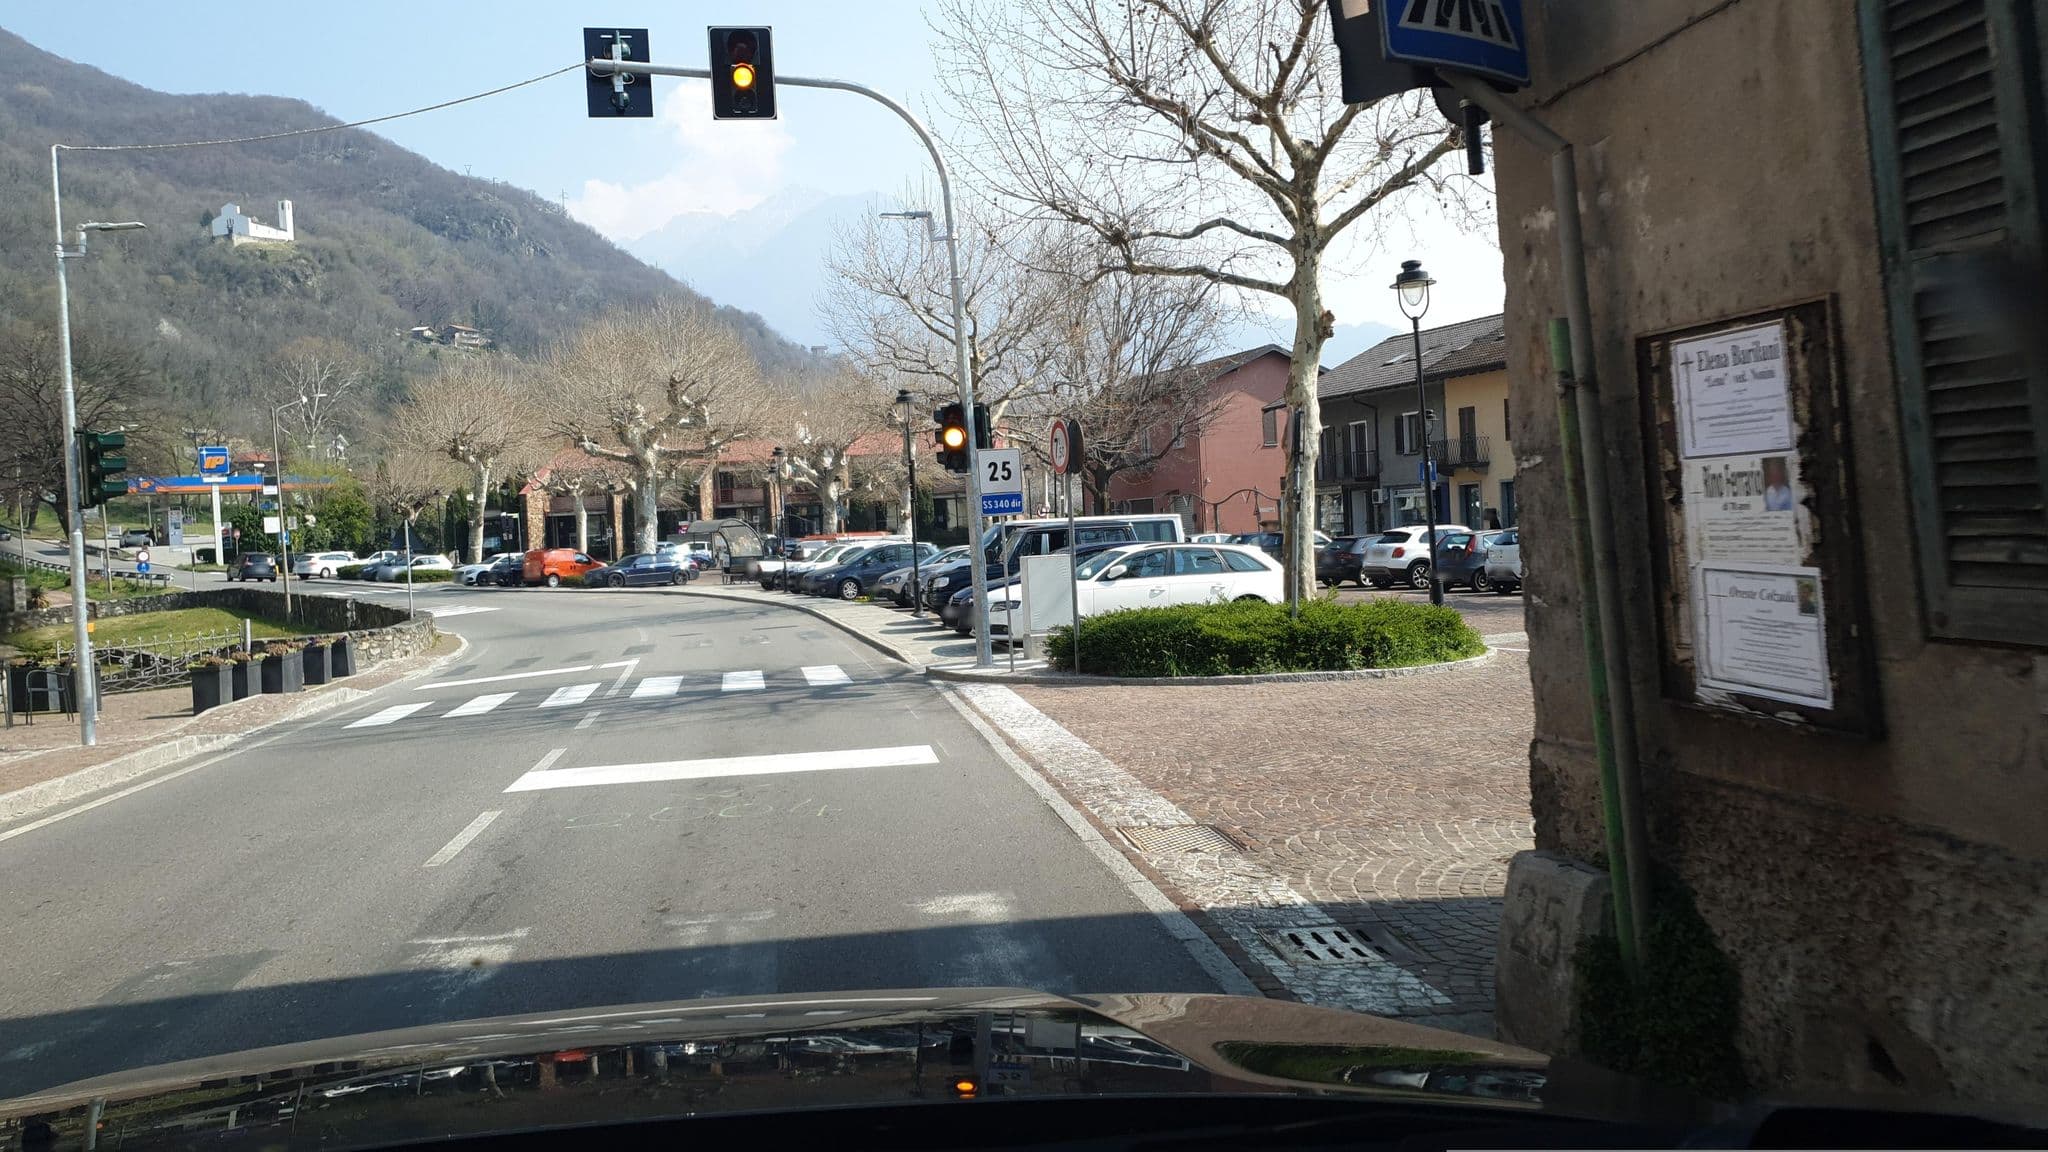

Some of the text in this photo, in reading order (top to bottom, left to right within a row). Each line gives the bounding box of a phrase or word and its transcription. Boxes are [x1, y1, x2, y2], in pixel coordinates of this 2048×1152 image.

[988, 461, 1012, 481] 25
[982, 498, 1021, 509] SS 340 dir
